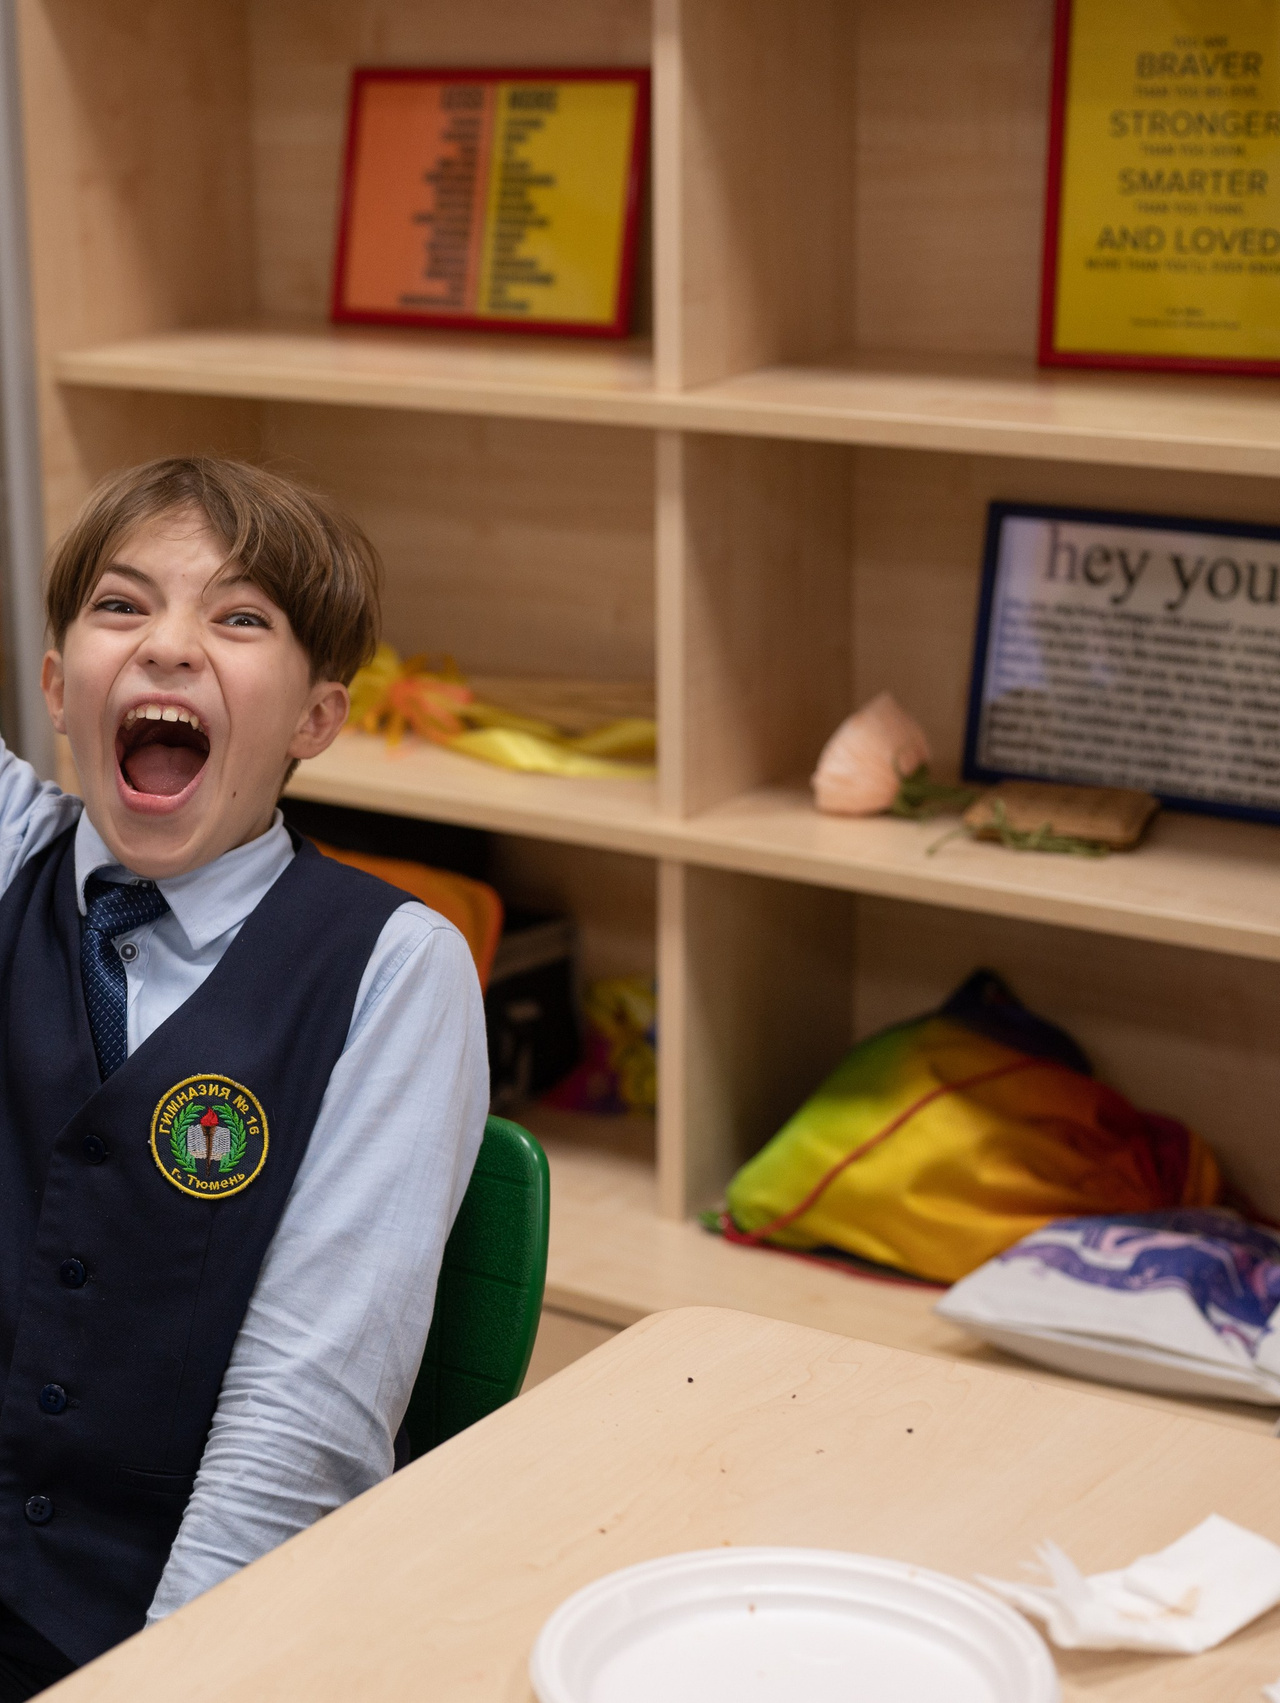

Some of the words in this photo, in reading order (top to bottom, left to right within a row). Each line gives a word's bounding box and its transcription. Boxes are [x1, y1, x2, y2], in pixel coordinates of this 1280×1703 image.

[1135, 50, 1264, 80] BRAVER
[1108, 108, 1280, 140] STRONGER
[1117, 167, 1269, 197] SMARTER
[1096, 223, 1166, 252] AND
[1173, 226, 1280, 257] LOVED
[1045, 520, 1150, 605] hey
[1166, 552, 1280, 611] you
[159, 1083, 231, 1134] ГИМНАЗИЯ
[232, 1094, 250, 1115] №
[246, 1116, 260, 1135] 16
[187, 1172, 245, 1191] Тюмень
